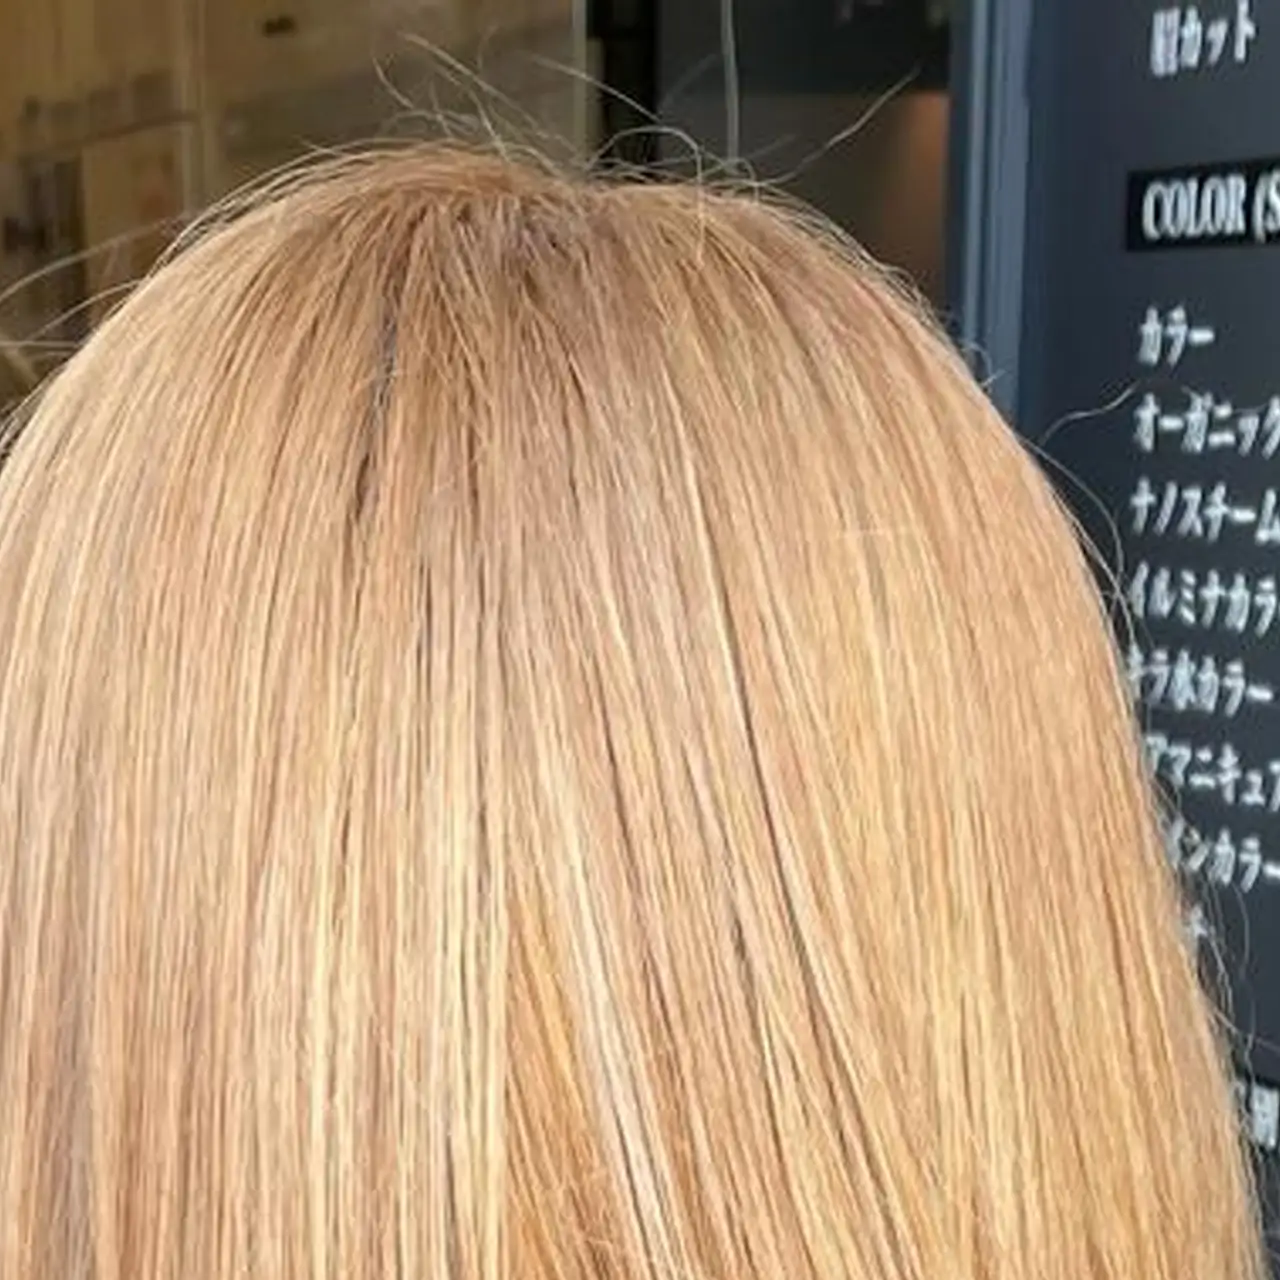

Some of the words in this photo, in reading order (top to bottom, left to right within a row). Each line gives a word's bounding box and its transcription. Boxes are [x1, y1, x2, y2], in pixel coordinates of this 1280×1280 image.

[1142, 174, 1247, 242] COLOR
[1138, 304, 1216, 368] カラー
